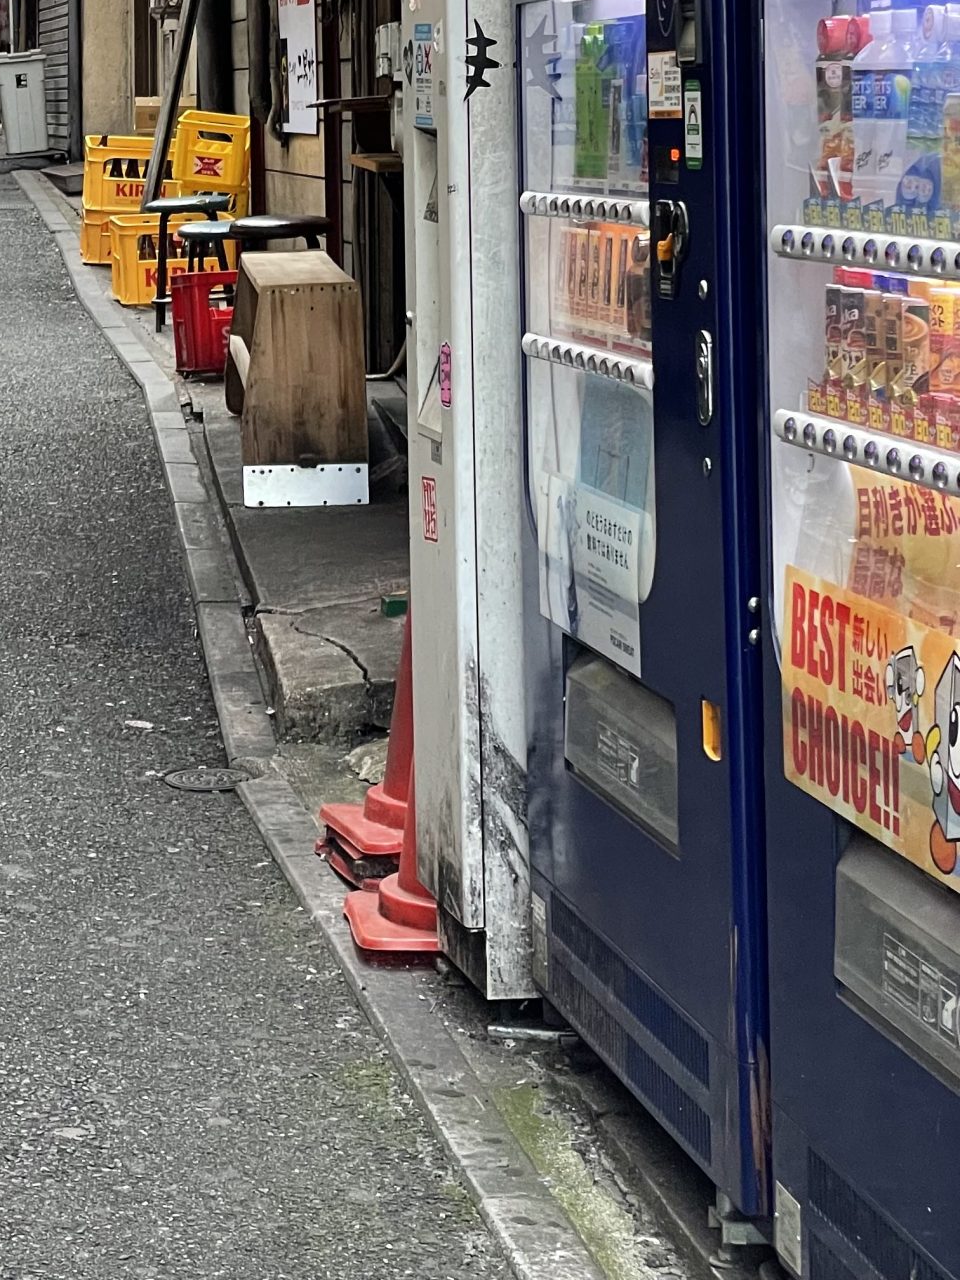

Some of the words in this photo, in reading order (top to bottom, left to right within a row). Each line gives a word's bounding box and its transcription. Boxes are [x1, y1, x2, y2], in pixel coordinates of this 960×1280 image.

[116, 183, 166, 198] KIRN
[790, 581, 851, 694] BEST
[852, 612, 889, 662] 新しい
[852, 658, 888, 707] 出会い
[791, 685, 901, 838] CHOICE!!
